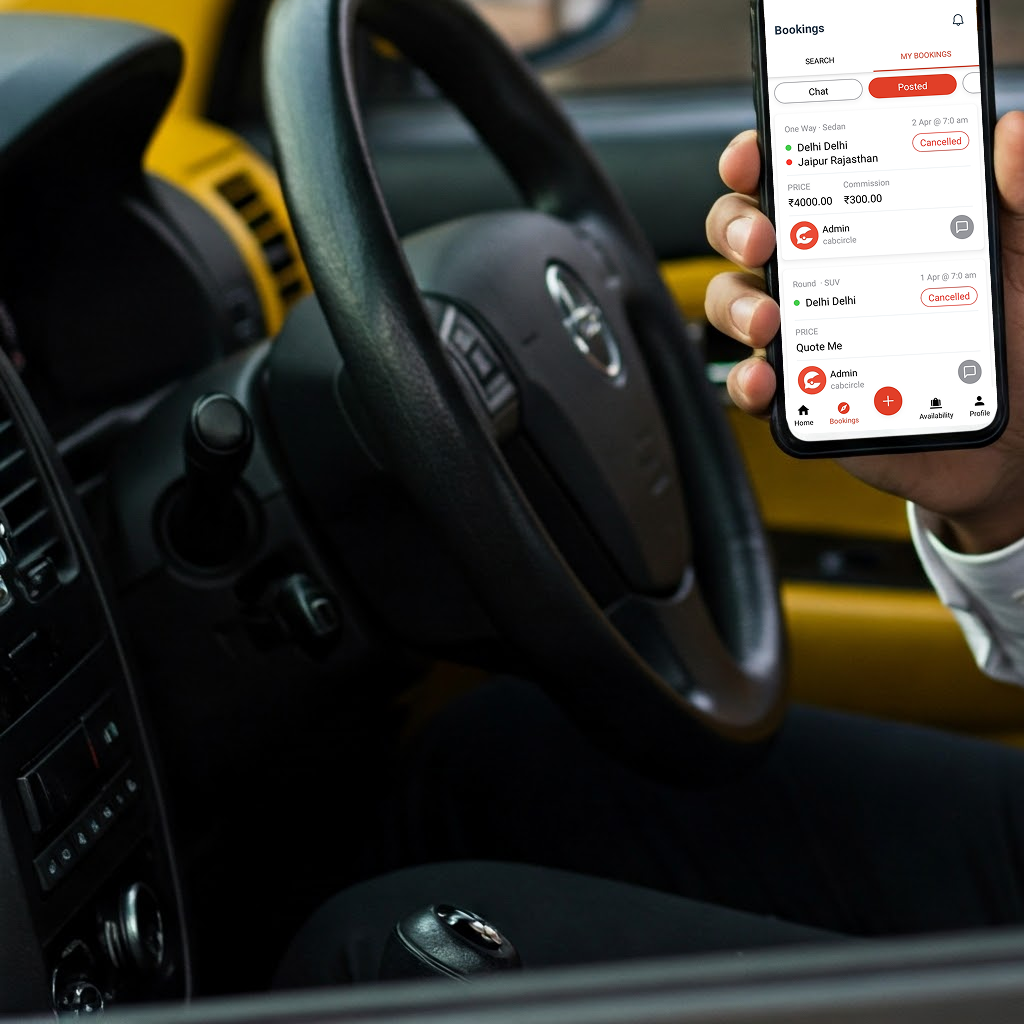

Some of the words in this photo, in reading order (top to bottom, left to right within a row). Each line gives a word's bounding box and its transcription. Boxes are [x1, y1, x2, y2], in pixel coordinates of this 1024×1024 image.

[774, 24, 824, 36] Bookings
[914, 50, 952, 60] BOOKINGS
[806, 56, 834, 66] SEARCH
[808, 88, 828, 96] Chat
[898, 82, 928, 92] Posted
[912, 118, 916, 126] 2
[918, 118, 932, 128] Apr
[934, 118, 942, 126] @
[942, 116, 954, 124] 7:0
[784, 126, 798, 134] One
[800, 124, 816, 134] Way
[822, 122, 846, 132] Sedan
[798, 142, 822, 152] Delhi
[824, 140, 848, 150] Delhi
[920, 136, 962, 148] Cancelled
[798, 156, 828, 168] Jaipur
[830, 154, 878, 166] Rajasthan
[788, 182, 810, 192] PRICE
[842, 180, 890, 188] Commission
[788, 196, 832, 208] ₹4000.00
[844, 194, 882, 204] ₹300.00
[822, 224, 850, 234] Admin
[822, 236, 856, 246] cabcircle
[920, 274, 924, 282] 1
[926, 274, 940, 282] Apr
[942, 272, 950, 282] @
[950, 272, 962, 280] 7:0
[792, 280, 816, 288] Round
[824, 278, 840, 286] SUV
[806, 298, 830, 308] Delhi
[832, 296, 856, 306] Delhi
[928, 292, 970, 302] Cancelled
[796, 328, 818, 336] PRICE
[796, 342, 826, 354] Quote
[828, 342, 842, 350] Me
[830, 370, 858, 378] Admin
[830, 380, 864, 390] cabcircle
[920, 412, 954, 420] Availability
